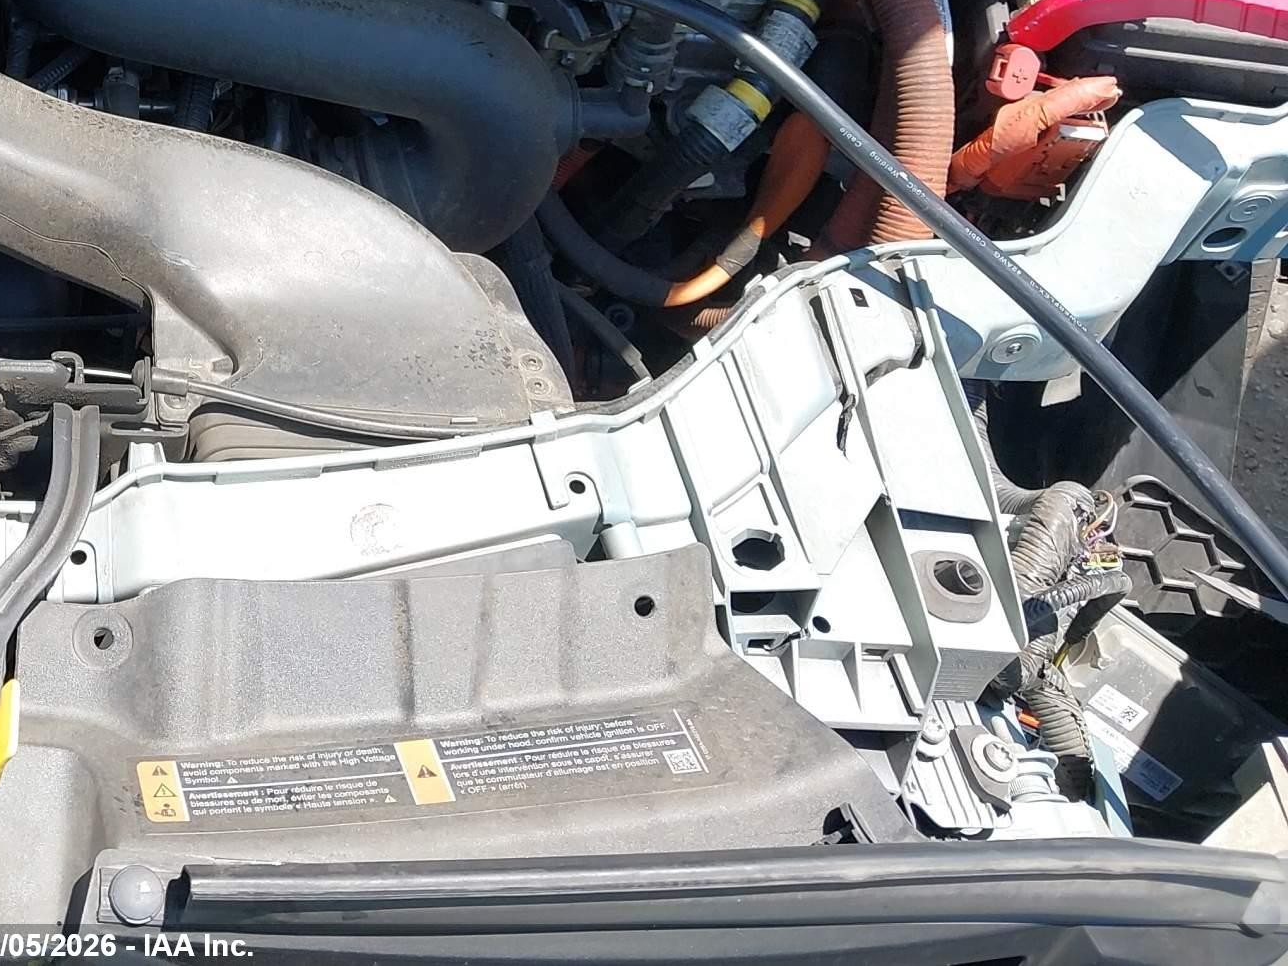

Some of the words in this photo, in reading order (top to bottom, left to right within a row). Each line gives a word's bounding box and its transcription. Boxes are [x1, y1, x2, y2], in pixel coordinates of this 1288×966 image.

[839, 126, 862, 148] Cable
[869, 150, 901, 179] Welding
[440, 737, 483, 749] Warning:
[499, 732, 527, 741] reduce
[530, 730, 545, 739] the
[547, 728, 563, 736] risk
[604, 719, 632, 729] before
[443, 746, 479, 757] working
[481, 744, 506, 753] under
[536, 736, 567, 746] confirm
[570, 731, 601, 741] vehicle
[603, 728, 636, 739] ignition
[181, 761, 224, 769] Warning:
[240, 757, 269, 766] reduce
[289, 754, 304, 762] risk
[318, 752, 343, 760] injury
[183, 769, 207, 777] avoid
[210, 765, 264, 777] components
[266, 763, 300, 771] marked
[302, 761, 321, 769] with
[323, 760, 337, 768] the
[339, 757, 360, 766] High
[363, 754, 396, 765] Voltage
[450, 758, 518, 771] Avertissement
[526, 753, 546, 763] Pour
[581, 748, 589, 756] le
[591, 745, 618, 756] risque
[620, 743, 632, 752] de
[634, 739, 676, 750] blessures
[452, 770, 470, 779] lors
[498, 761, 549, 774] intervention
[552, 759, 571, 768] sous
[573, 758, 582, 766] le
[456, 779, 473, 787] que
[476, 777, 484, 785] le
[486, 770, 543, 783] commutateur
[596, 763, 610, 771] est
[625, 757, 659, 768] position
[189, 790, 259, 800] Avertissement
[267, 787, 288, 795] Pour
[324, 783, 334, 791] le
[336, 781, 364, 790] risque
[191, 799, 234, 807] blessures
[251, 796, 263, 804] de
[334, 788, 389, 800] composants
[467, 785, 487, 794] OFF
[193, 808, 207, 816] qui
[209, 805, 241, 816] portent
[244, 805, 252, 813] le
[304, 801, 331, 809] Haute
[333, 798, 367, 807] tension
